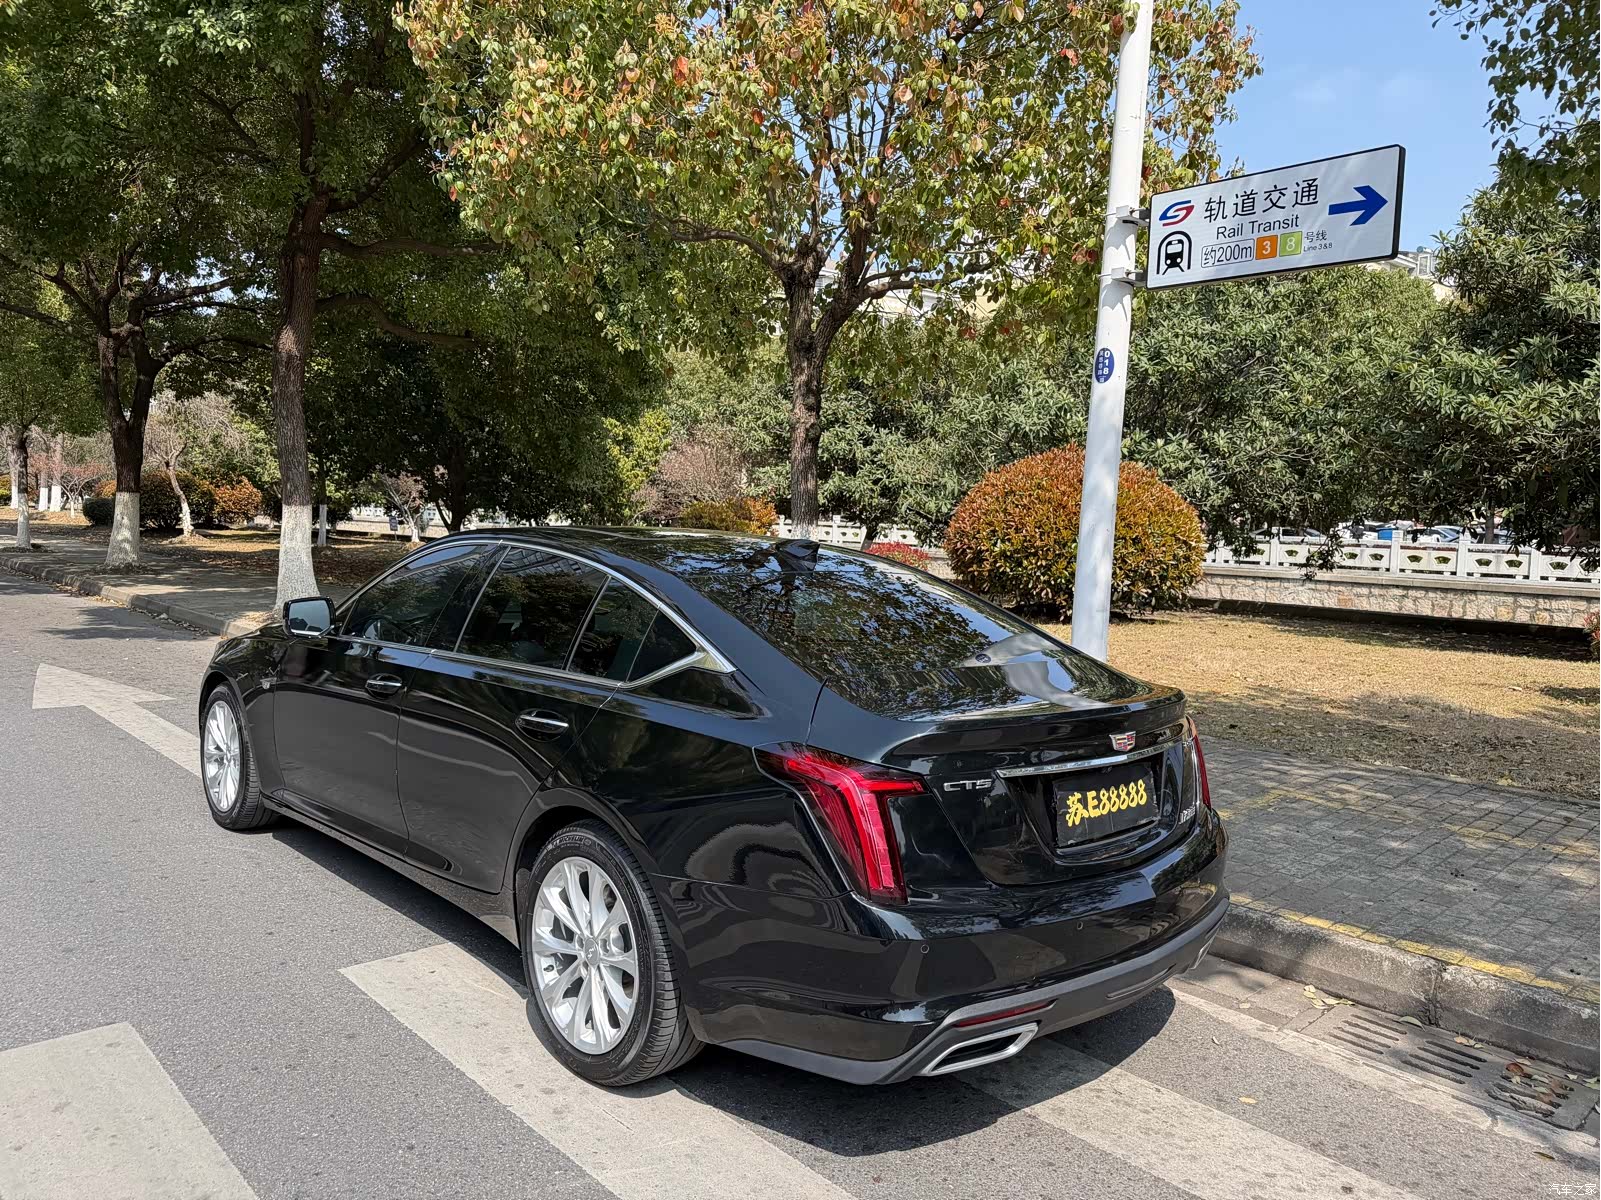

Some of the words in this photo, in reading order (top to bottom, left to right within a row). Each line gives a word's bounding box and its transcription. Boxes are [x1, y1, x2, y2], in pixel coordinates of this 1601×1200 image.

[1204, 178, 1318, 223] 轨道交通
[1216, 222, 1244, 240] Rail
[1248, 213, 1300, 234] Transit
[1203, 243, 1252, 266] 约200m
[1262, 240, 1271, 255] 3
[1286, 236, 1296, 251] 8
[1304, 229, 1328, 242] 号线
[1066, 779, 1147, 827] 苏E88888
